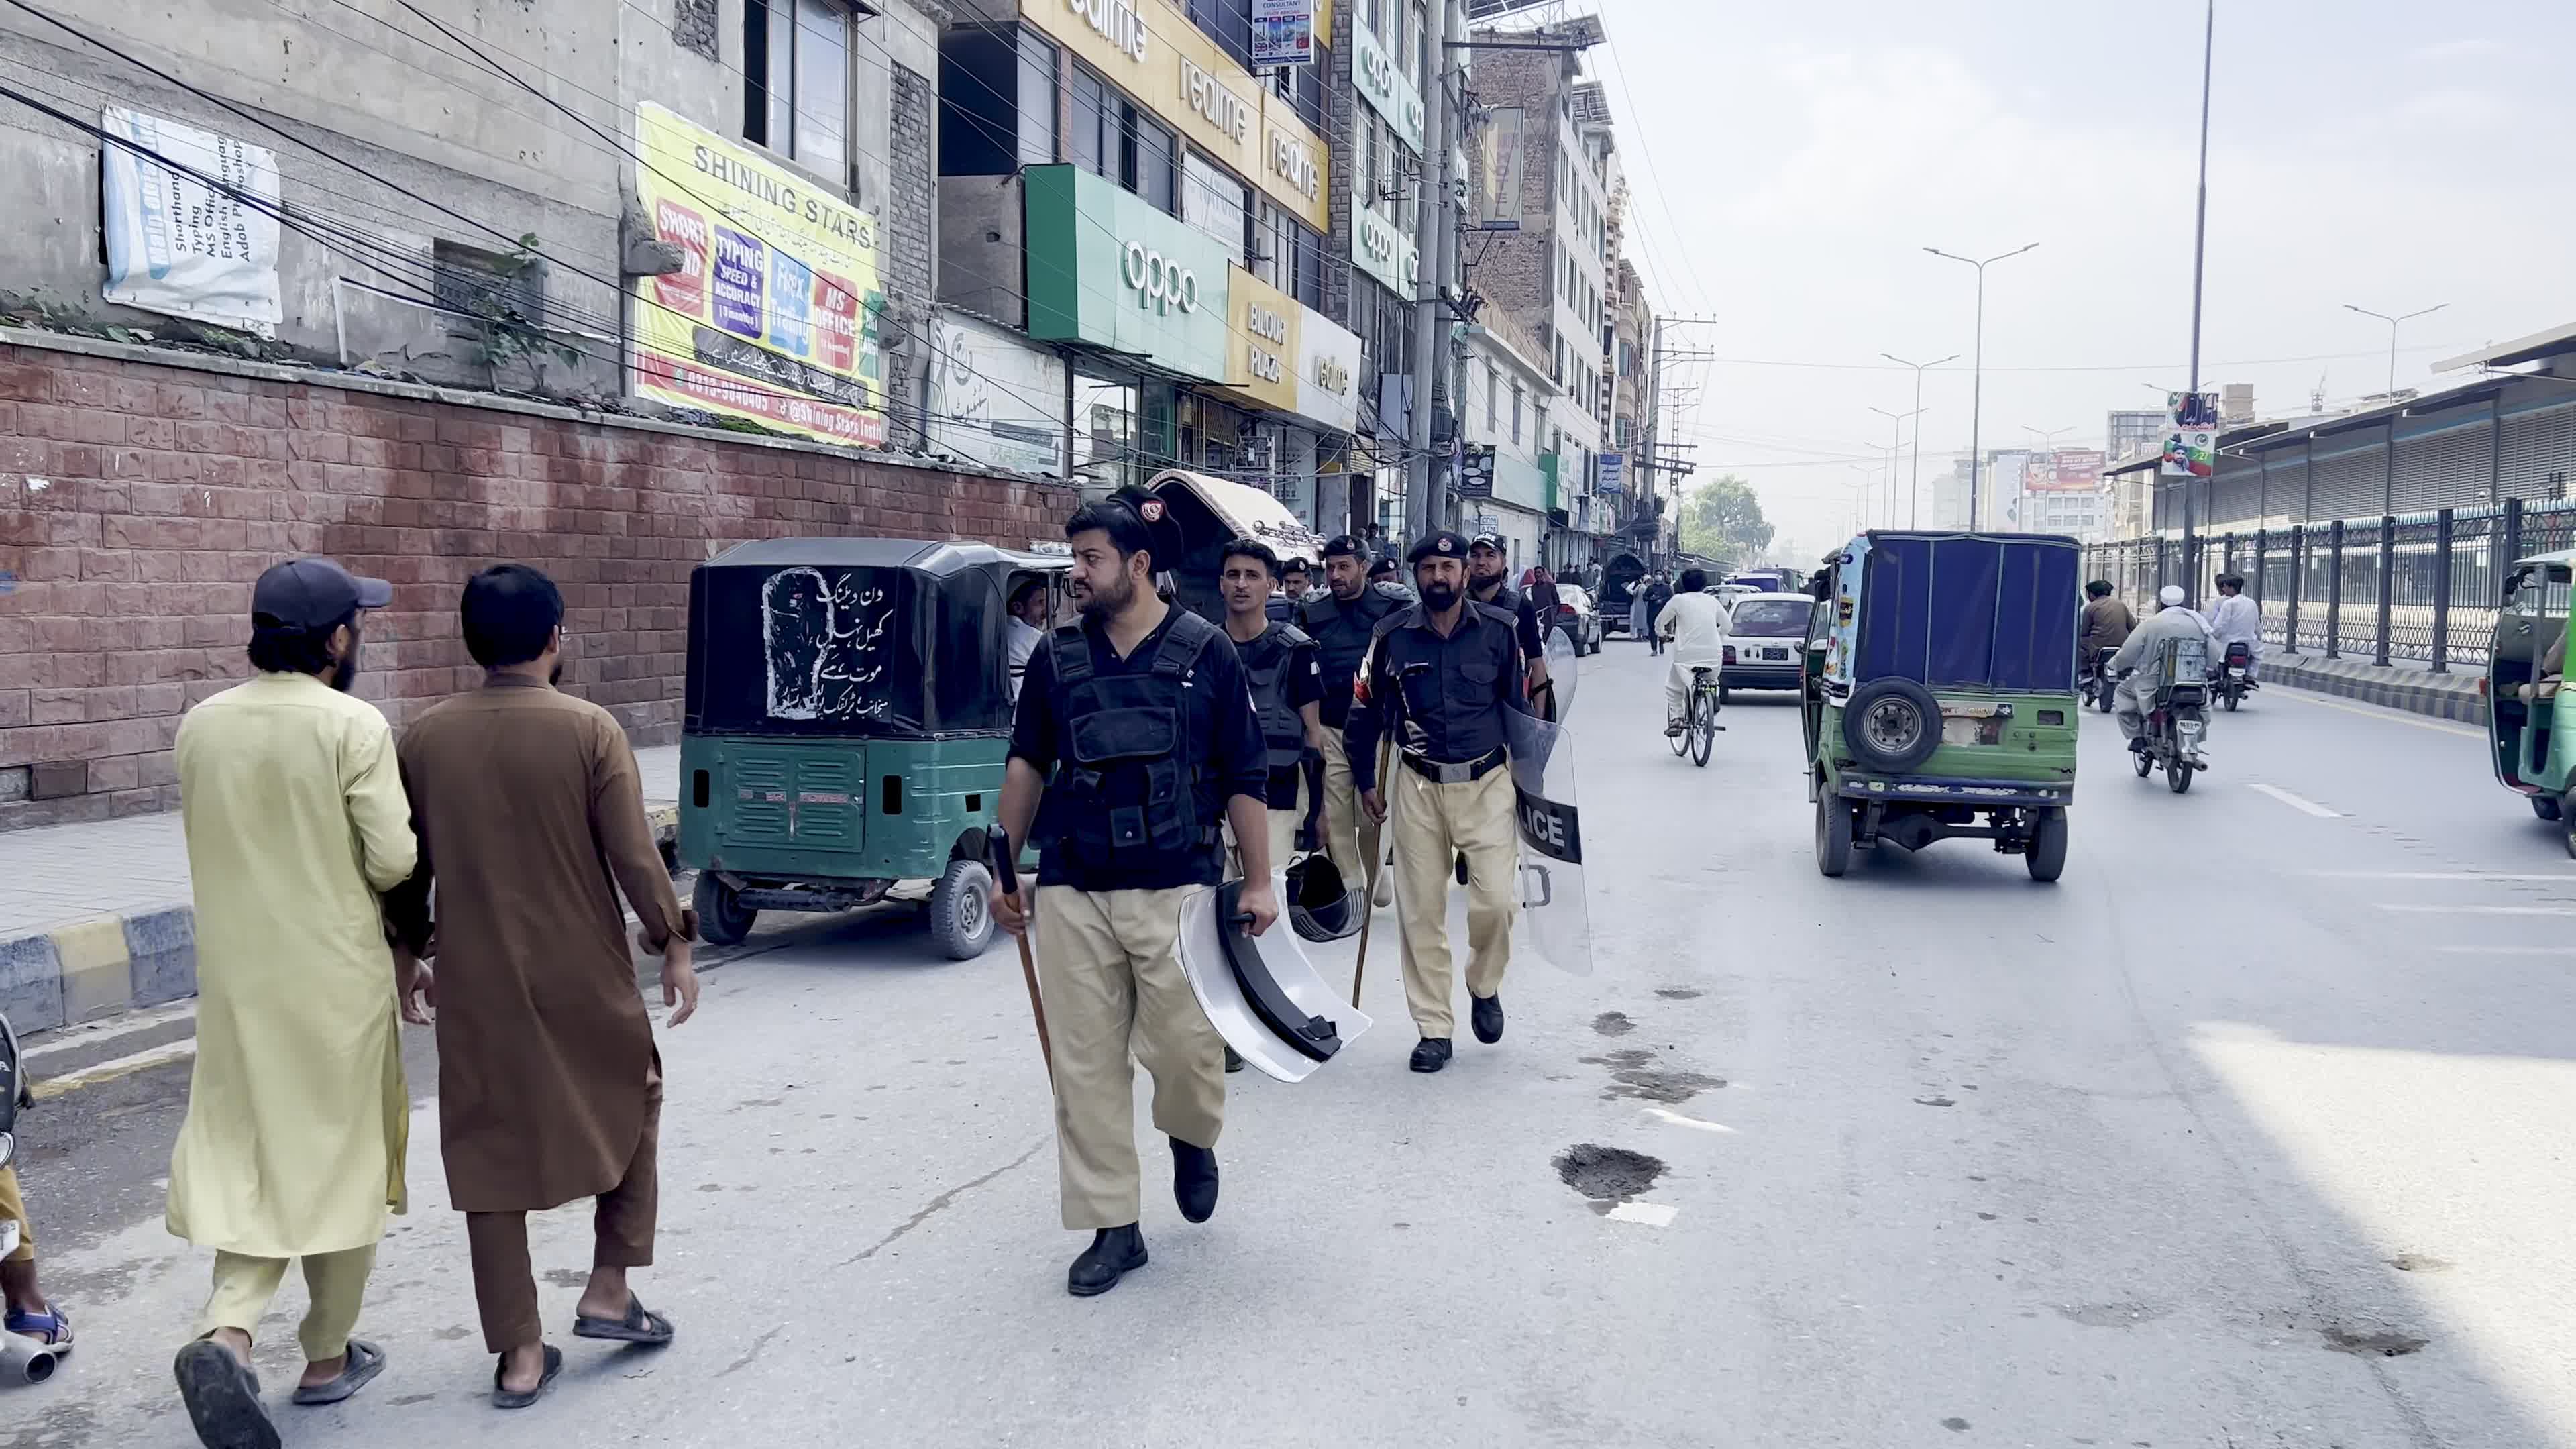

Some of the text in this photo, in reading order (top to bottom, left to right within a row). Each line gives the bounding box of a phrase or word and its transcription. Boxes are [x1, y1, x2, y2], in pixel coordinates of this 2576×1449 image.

[1366, 47, 1393, 97] oppo
[1181, 58, 1246, 145] realme
[1270, 129, 1319, 203] realme
[171, 169, 187, 252] Shorthand
[694, 144, 797, 213] SHINING
[805, 198, 871, 250] STARS
[189, 205, 203, 254] Typing
[206, 233, 215, 257] MS
[217, 207, 233, 259] English
[237, 223, 250, 262] Adob
[659, 204, 705, 248] SHORT
[1365, 221, 1391, 262] oppo
[716, 235, 763, 272] TYPING
[715, 282, 761, 308] ACCURACY
[720, 266, 757, 290] SPEED &
[1124, 241, 1198, 317] oppo
[825, 287, 845, 311] MS
[815, 307, 856, 337] OFFICE
[1248, 301, 1286, 345] BILOUR
[1248, 345, 1281, 384] PLAZA
[1314, 356, 1348, 396] realme
[835, 413, 859, 434] Stars
